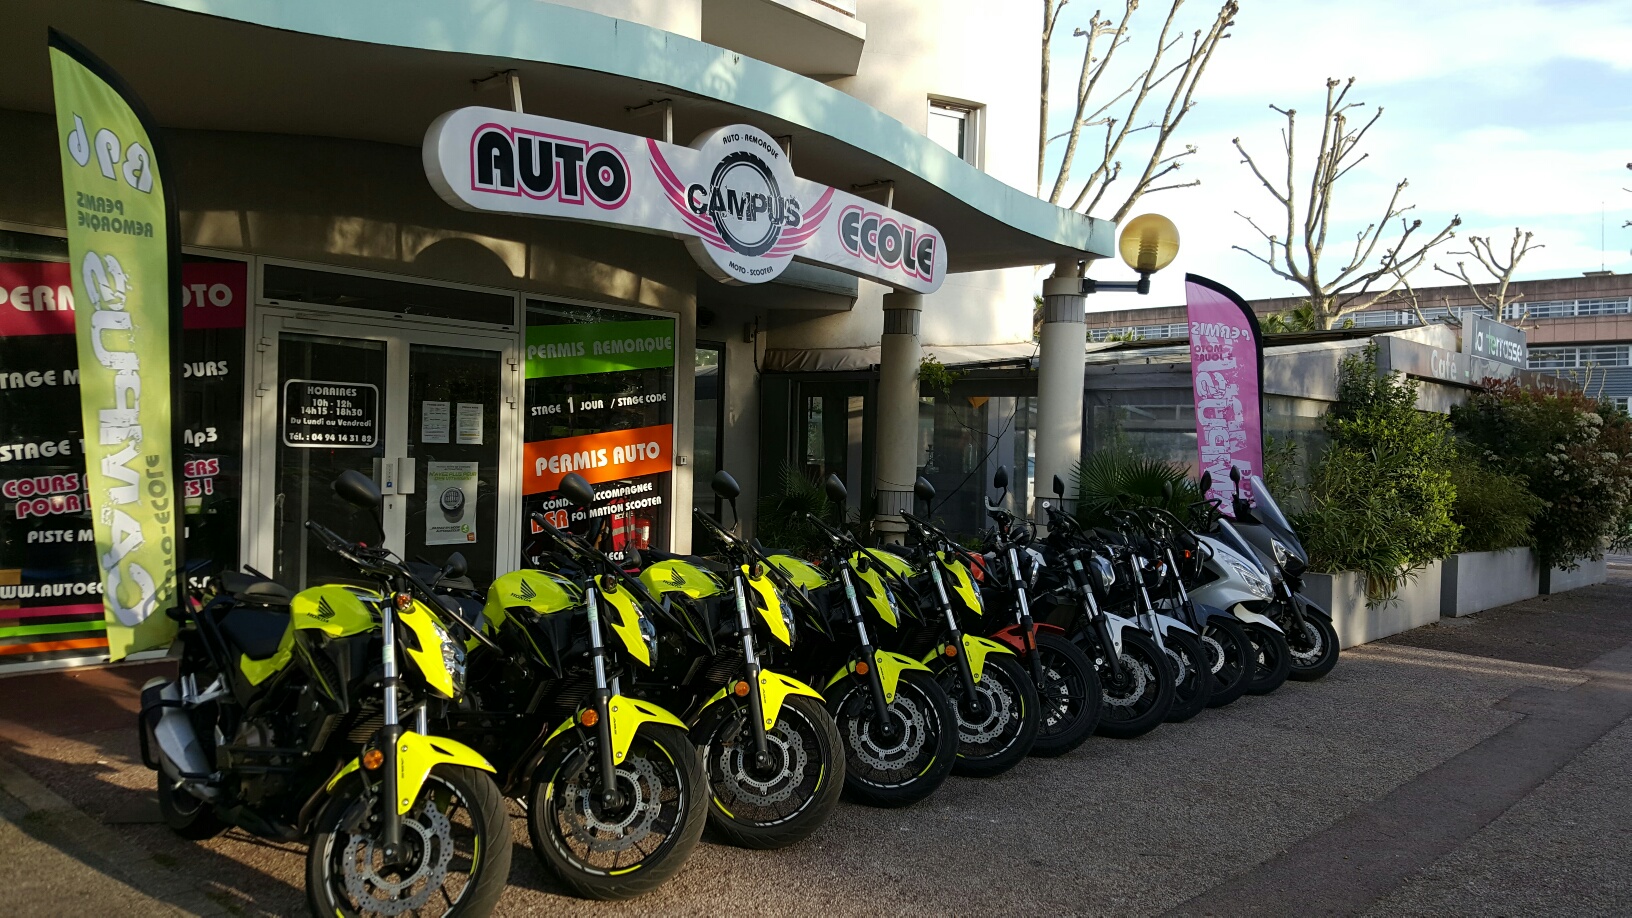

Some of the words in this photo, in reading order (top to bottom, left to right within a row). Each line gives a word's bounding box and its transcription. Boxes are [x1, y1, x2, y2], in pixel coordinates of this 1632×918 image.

[722, 133, 740, 145] AUTO
[744, 133, 779, 159] REMORQUE
[476, 130, 628, 203] AUTO
[686, 183, 802, 229] CAMPUS
[841, 211, 934, 276] ECOLE
[728, 260, 746, 274] MOTO
[750, 265, 774, 276] SCOOTER
[527, 341, 585, 360] PERMIS
[593, 336, 672, 356] REMORQUE
[1475, 320, 1484, 352] la
[1430, 349, 1457, 380] Café
[307, 386, 357, 397] HORAIRES
[312, 398, 328, 407] 10h
[336, 399, 352, 408] 12h
[301, 406, 328, 415] 14h15
[336, 408, 363, 416] 18h30
[531, 403, 562, 417] STAGE
[567, 396, 575, 414] 1
[580, 399, 604, 411] JOUR
[617, 395, 643, 407] STAGE
[645, 392, 667, 403] CODE
[303, 417, 324, 425] Lundi
[337, 418, 371, 427] Vendredi
[289, 432, 304, 441] Tél.
[311, 433, 323, 441] 04
[325, 434, 335, 442] 94
[338, 434, 347, 442] 14
[349, 434, 358, 442] 31
[0, 440, 71, 462] STAGE
[535, 448, 608, 477] PERMIS
[613, 441, 660, 465] AUTO
[2, 473, 80, 498] COURS
[15, 494, 81, 519] POUR
[543, 498, 574, 510] COND
[625, 496, 662, 510] SCOOTER
[27, 530, 74, 543] PISTE
